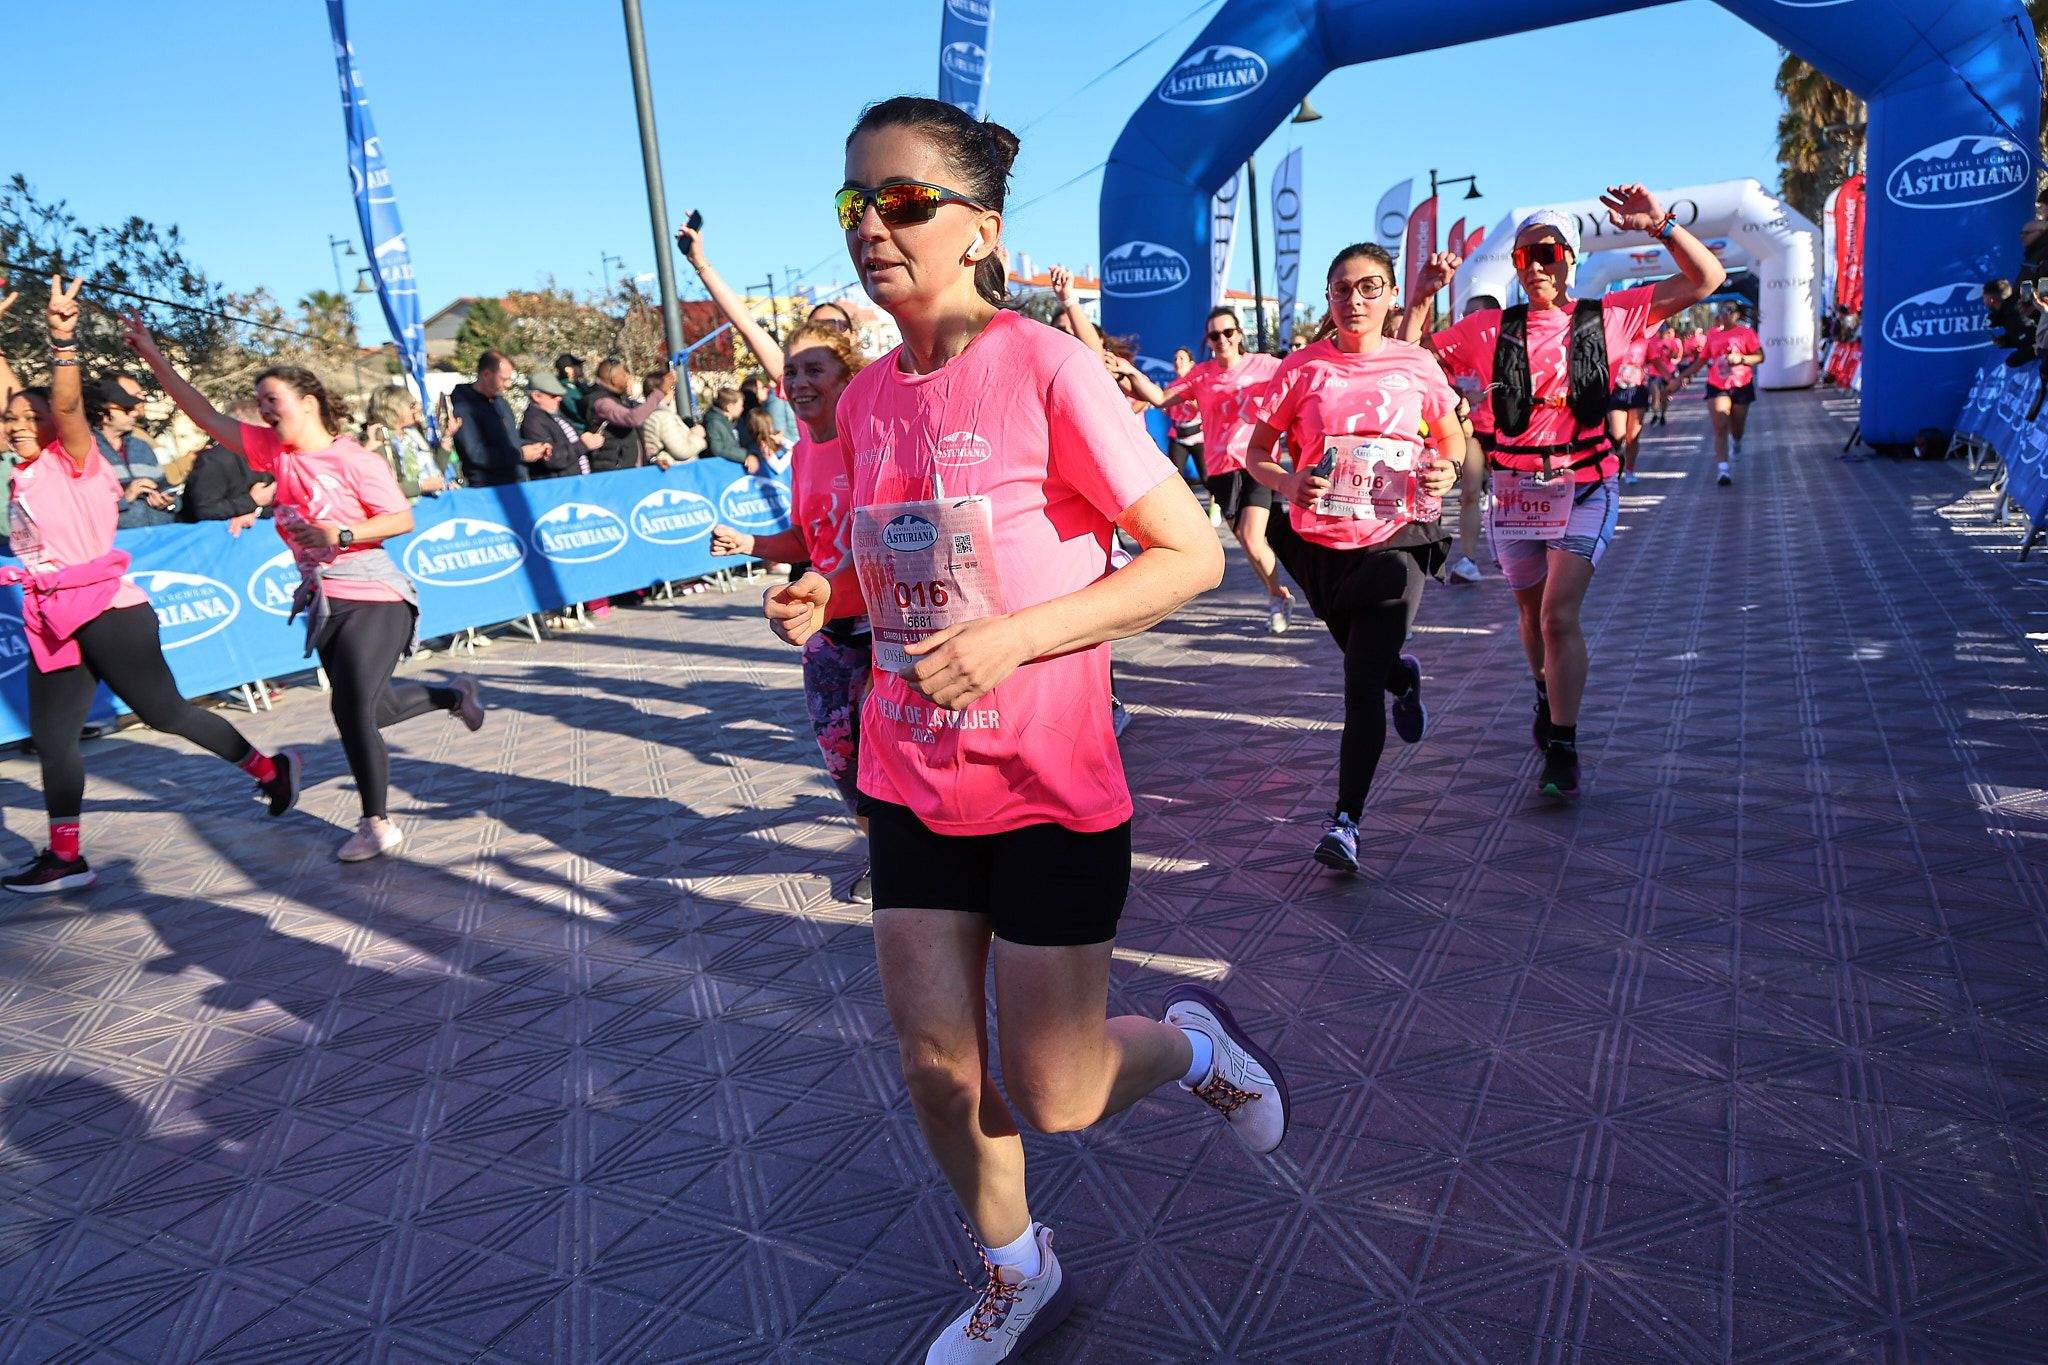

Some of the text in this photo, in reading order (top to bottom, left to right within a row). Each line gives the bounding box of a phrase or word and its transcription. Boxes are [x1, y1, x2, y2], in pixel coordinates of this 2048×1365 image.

[1164, 67, 1258, 96] ASTURIANA
[1917, 159, 1971, 174] CENTRAL
[1896, 164, 2023, 198] ASTURIANA
[1104, 266, 1183, 286] ASTURIANA
[1912, 305, 1964, 318] CENTRAL
[1891, 313, 1992, 339] ASTURIA
[1352, 474, 1384, 489] 016
[1522, 501, 1551, 513] 016
[638, 509, 713, 535] ASTURIANA
[541, 526, 622, 552] ASTURIANA
[886, 528, 935, 544] ASTURIANA
[417, 541, 521, 576] ASTURIANA
[894, 580, 949, 609] 016
[158, 597, 230, 627] RIANA
[907, 616, 932, 628] 5681
[884, 648, 912, 664] OYSHO
[905, 704, 923, 725] DE
[947, 709, 1000, 730] MUJER
[911, 727, 936, 744] 2025
